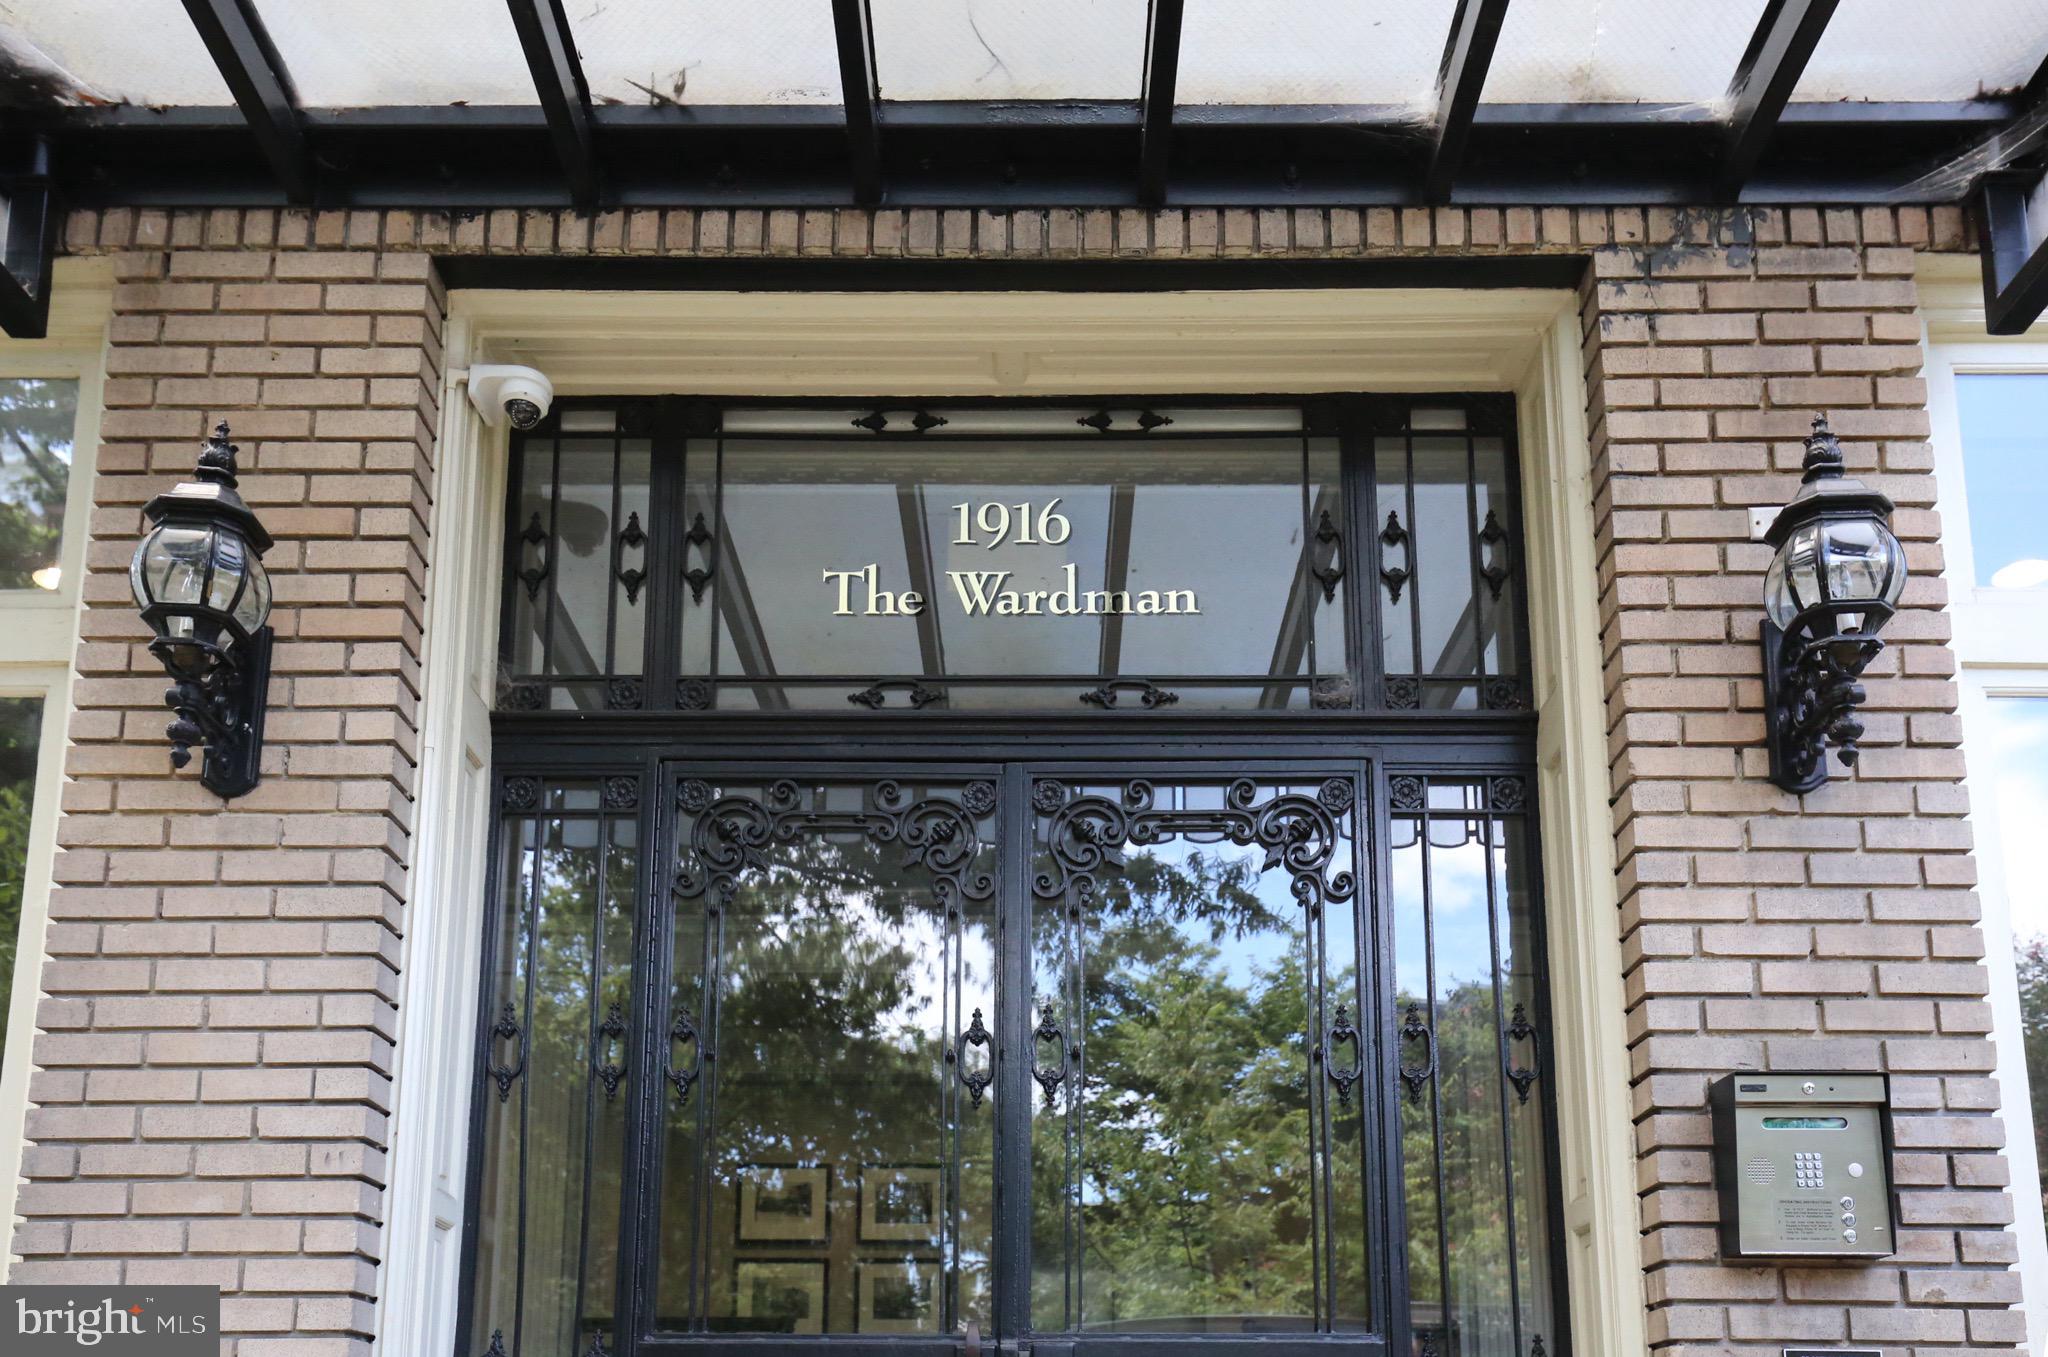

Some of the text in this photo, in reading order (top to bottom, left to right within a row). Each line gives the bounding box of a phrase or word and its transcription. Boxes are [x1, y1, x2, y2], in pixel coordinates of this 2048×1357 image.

[951, 498, 1072, 549] 1916
[823, 562, 1201, 615] The Wardman
